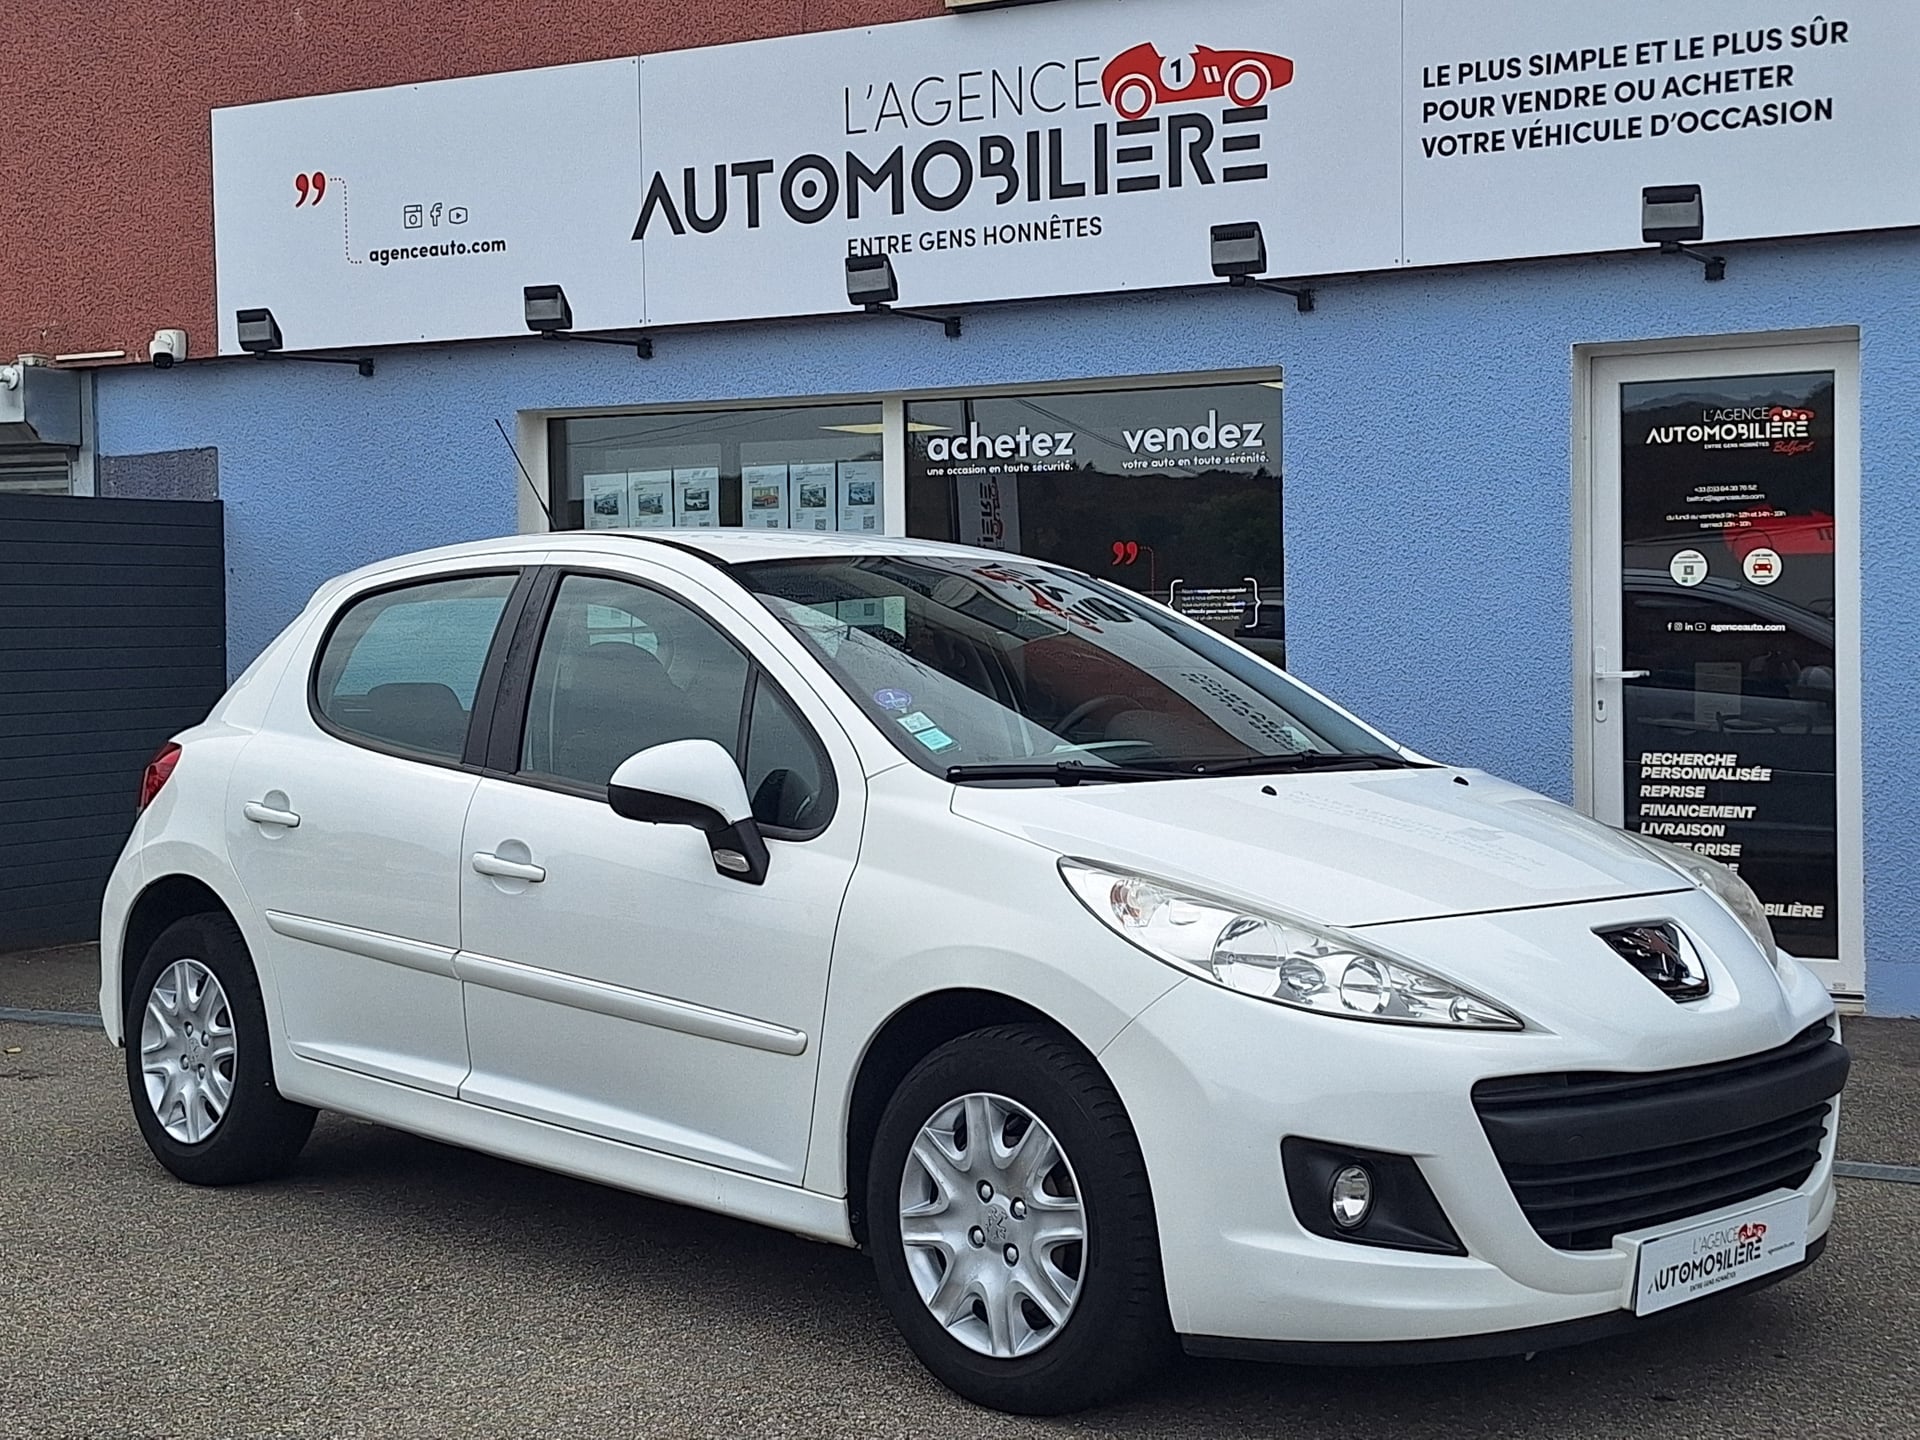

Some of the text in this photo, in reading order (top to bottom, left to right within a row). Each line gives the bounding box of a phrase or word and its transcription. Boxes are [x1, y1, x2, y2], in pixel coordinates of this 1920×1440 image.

[1423, 15, 1849, 88] LE PLUS SIMPLE ET LE PLUS SÛR
[845, 55, 1102, 135] L'AGENCE
[1422, 65, 1794, 123] POUR VENDRE OU ACHETER
[1422, 97, 1834, 159] VOTRE VÉHICULE D'OCCASION
[847, 214, 1103, 258] ENTRE GENS HONNÊTES
[369, 240, 506, 266] agenceauto.com
[1703, 406, 1770, 422] L'AGENCE
[1122, 409, 1264, 454] vendez
[926, 421, 1074, 462] achetez
[927, 460, 1073, 476] une occasion en toute sécurité.
[1122, 459, 1148, 469] votre
[1151, 458, 1175, 468] auto
[1194, 455, 1221, 465] toute
[1225, 452, 1269, 464] sérénité.
[1711, 624, 1786, 632] agenceauto.com
[1640, 752, 1737, 766] RECHERCHE
[1640, 766, 1772, 781] PERSONNALISÉE
[1640, 785, 1706, 798] REPRISE
[1640, 804, 1756, 818] FINANCEMENT
[1640, 822, 1725, 837] LIVRAISON
[1694, 843, 1742, 857] GRISE
